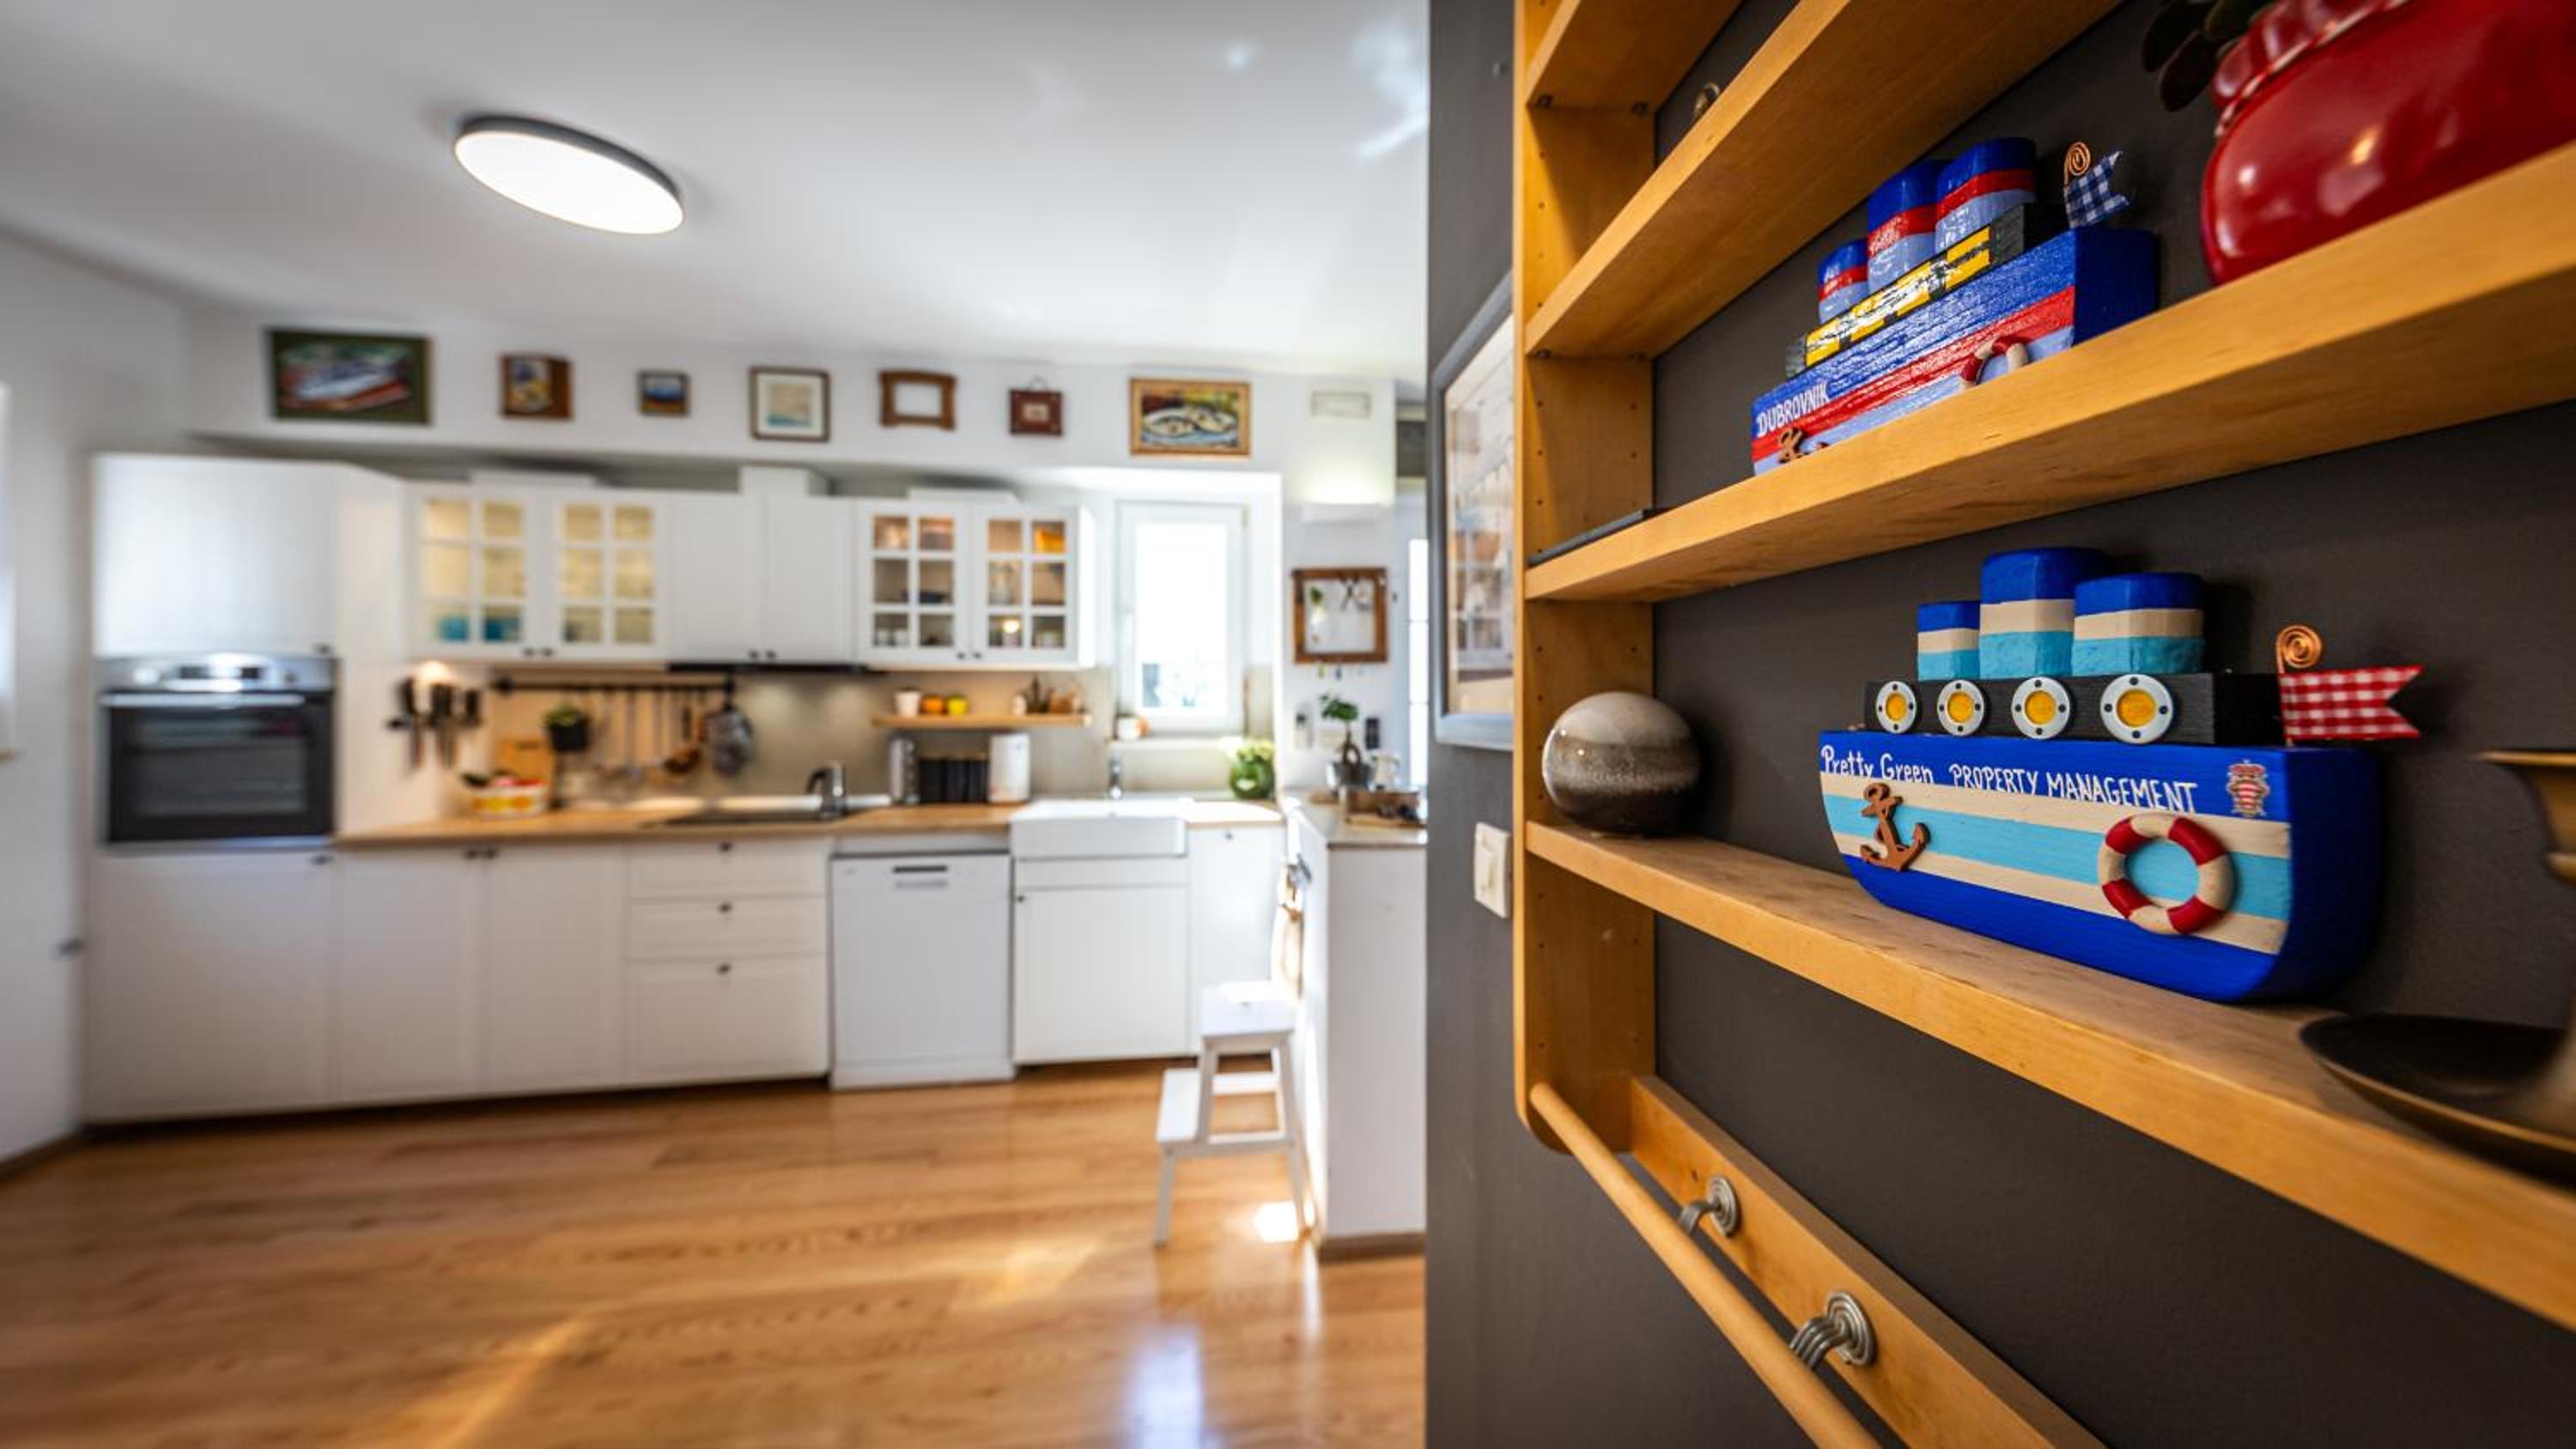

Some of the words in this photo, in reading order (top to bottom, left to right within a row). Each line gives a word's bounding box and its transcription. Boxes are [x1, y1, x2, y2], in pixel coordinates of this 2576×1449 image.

[1756, 382, 1830, 437] DUBROVNIK
[1821, 744, 1874, 778] Pretty
[1880, 753, 1934, 784] Green
[1949, 763, 2038, 794] PROPERTY
[2047, 772, 2198, 813] MANAGEMENT
